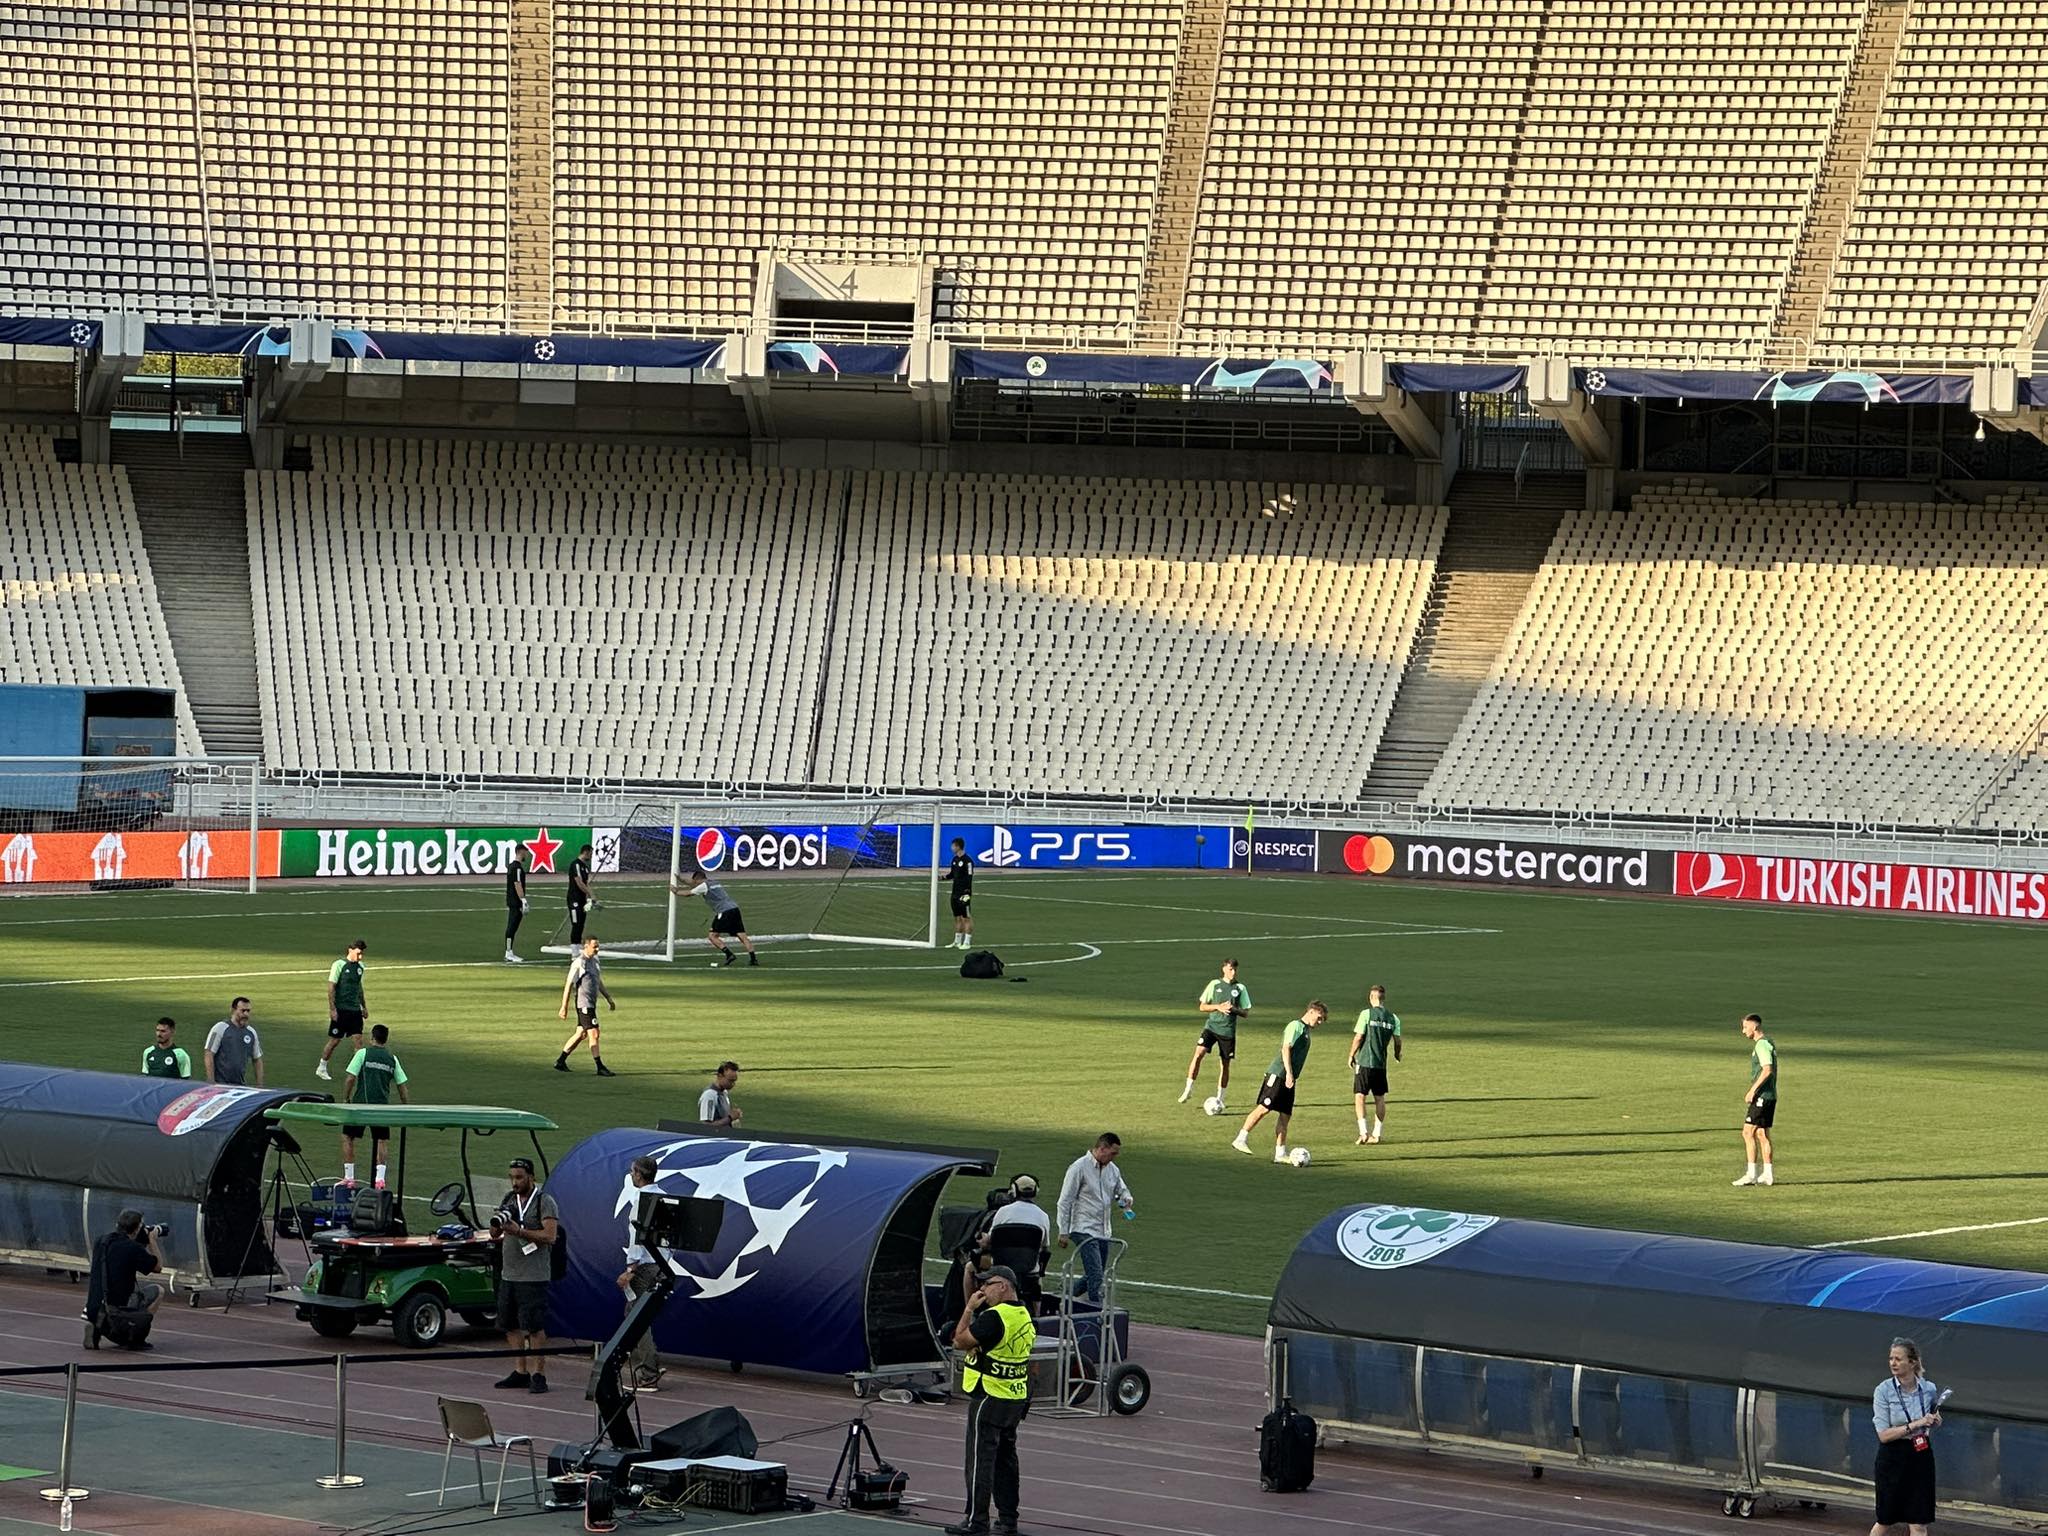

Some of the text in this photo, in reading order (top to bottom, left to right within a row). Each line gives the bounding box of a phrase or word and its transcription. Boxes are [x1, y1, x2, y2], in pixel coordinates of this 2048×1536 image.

[838, 268, 858, 299] 4
[316, 829, 518, 876] Heineken
[733, 826, 827, 871] pepsi
[1030, 833, 1130, 860] PS5
[1254, 842, 1314, 857] RESPECT
[1407, 842, 1648, 886] mastercard
[1756, 857, 2047, 919] TURKISH AIRLINES
[1362, 1245, 1407, 1262] 1908
